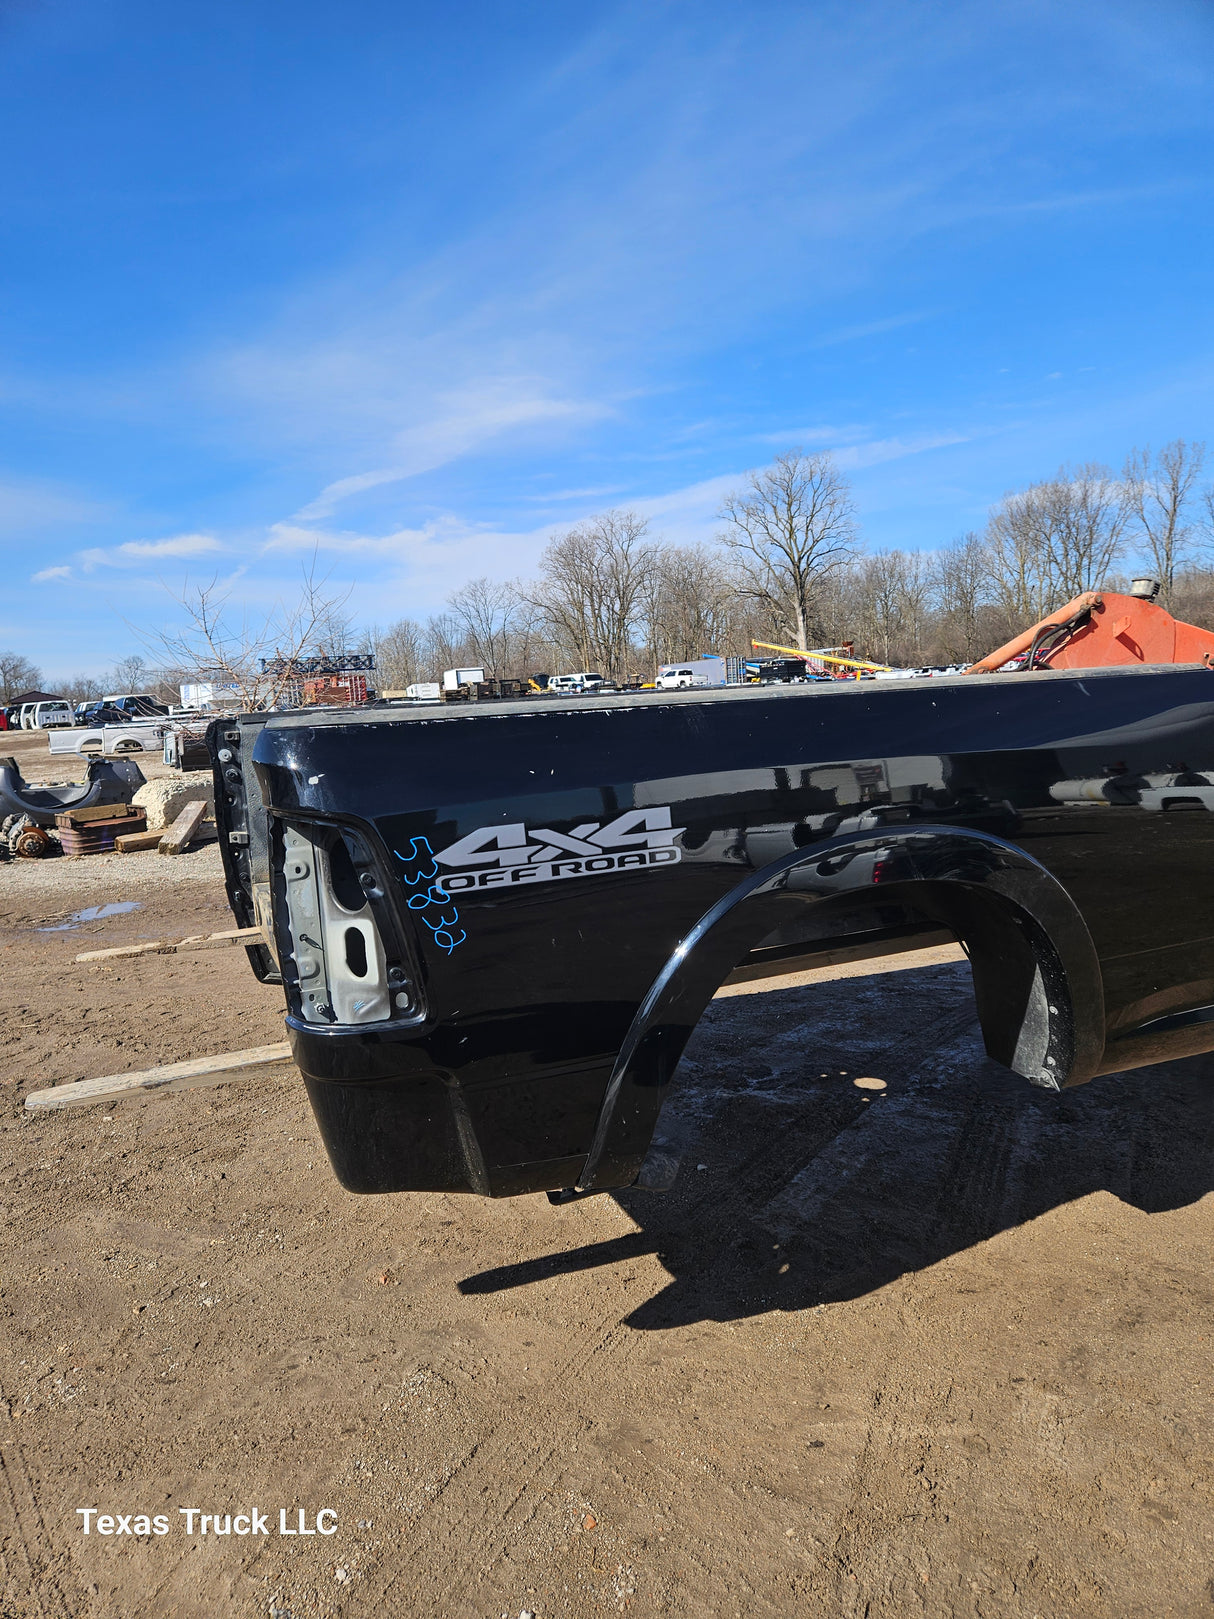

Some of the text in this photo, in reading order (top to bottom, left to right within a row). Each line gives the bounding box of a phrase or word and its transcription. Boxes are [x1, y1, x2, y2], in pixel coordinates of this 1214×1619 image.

[394, 836, 467, 956] 53832
[440, 849, 677, 891] OFF ROAD
